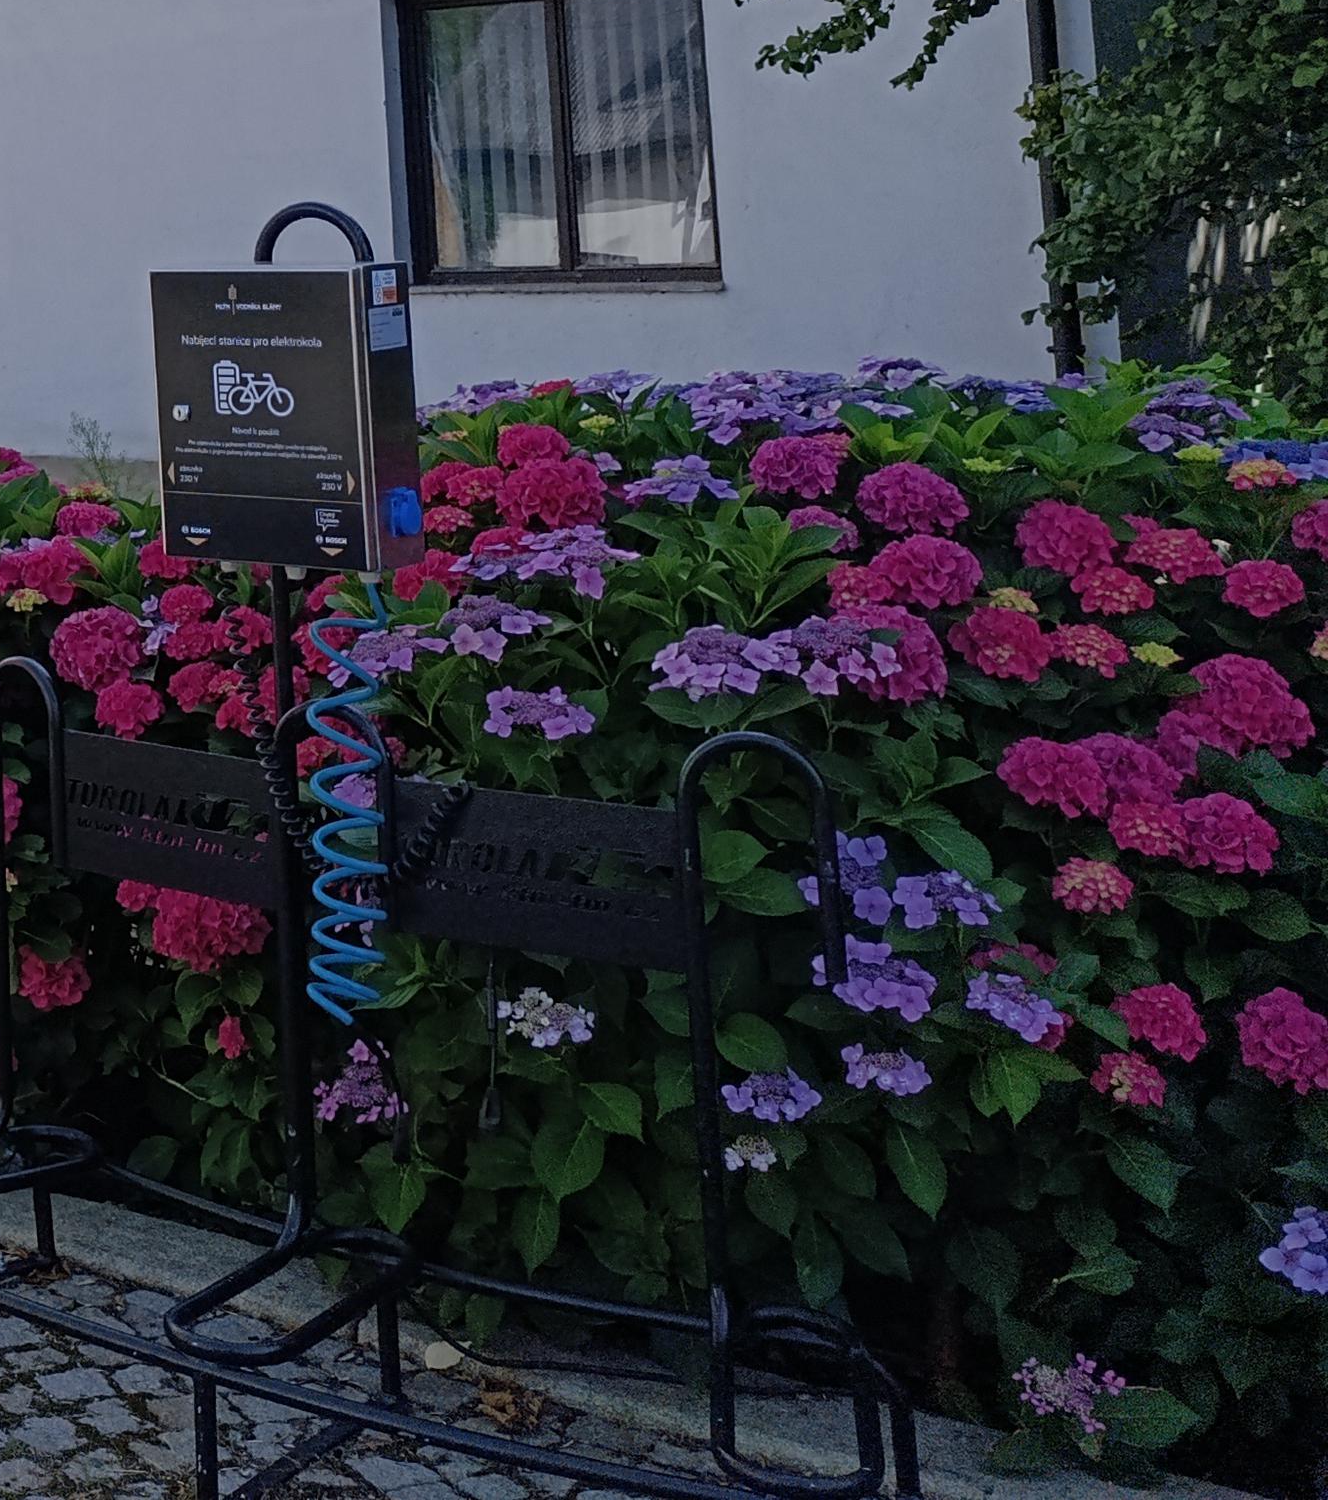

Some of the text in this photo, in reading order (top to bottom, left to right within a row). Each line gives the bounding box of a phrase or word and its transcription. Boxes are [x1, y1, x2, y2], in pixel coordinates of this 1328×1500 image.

[219, 336, 251, 346] stanice
[253, 338, 269, 348] pro
[270, 336, 322, 348] elektrokola
[321, 482, 343, 492] 230 V
